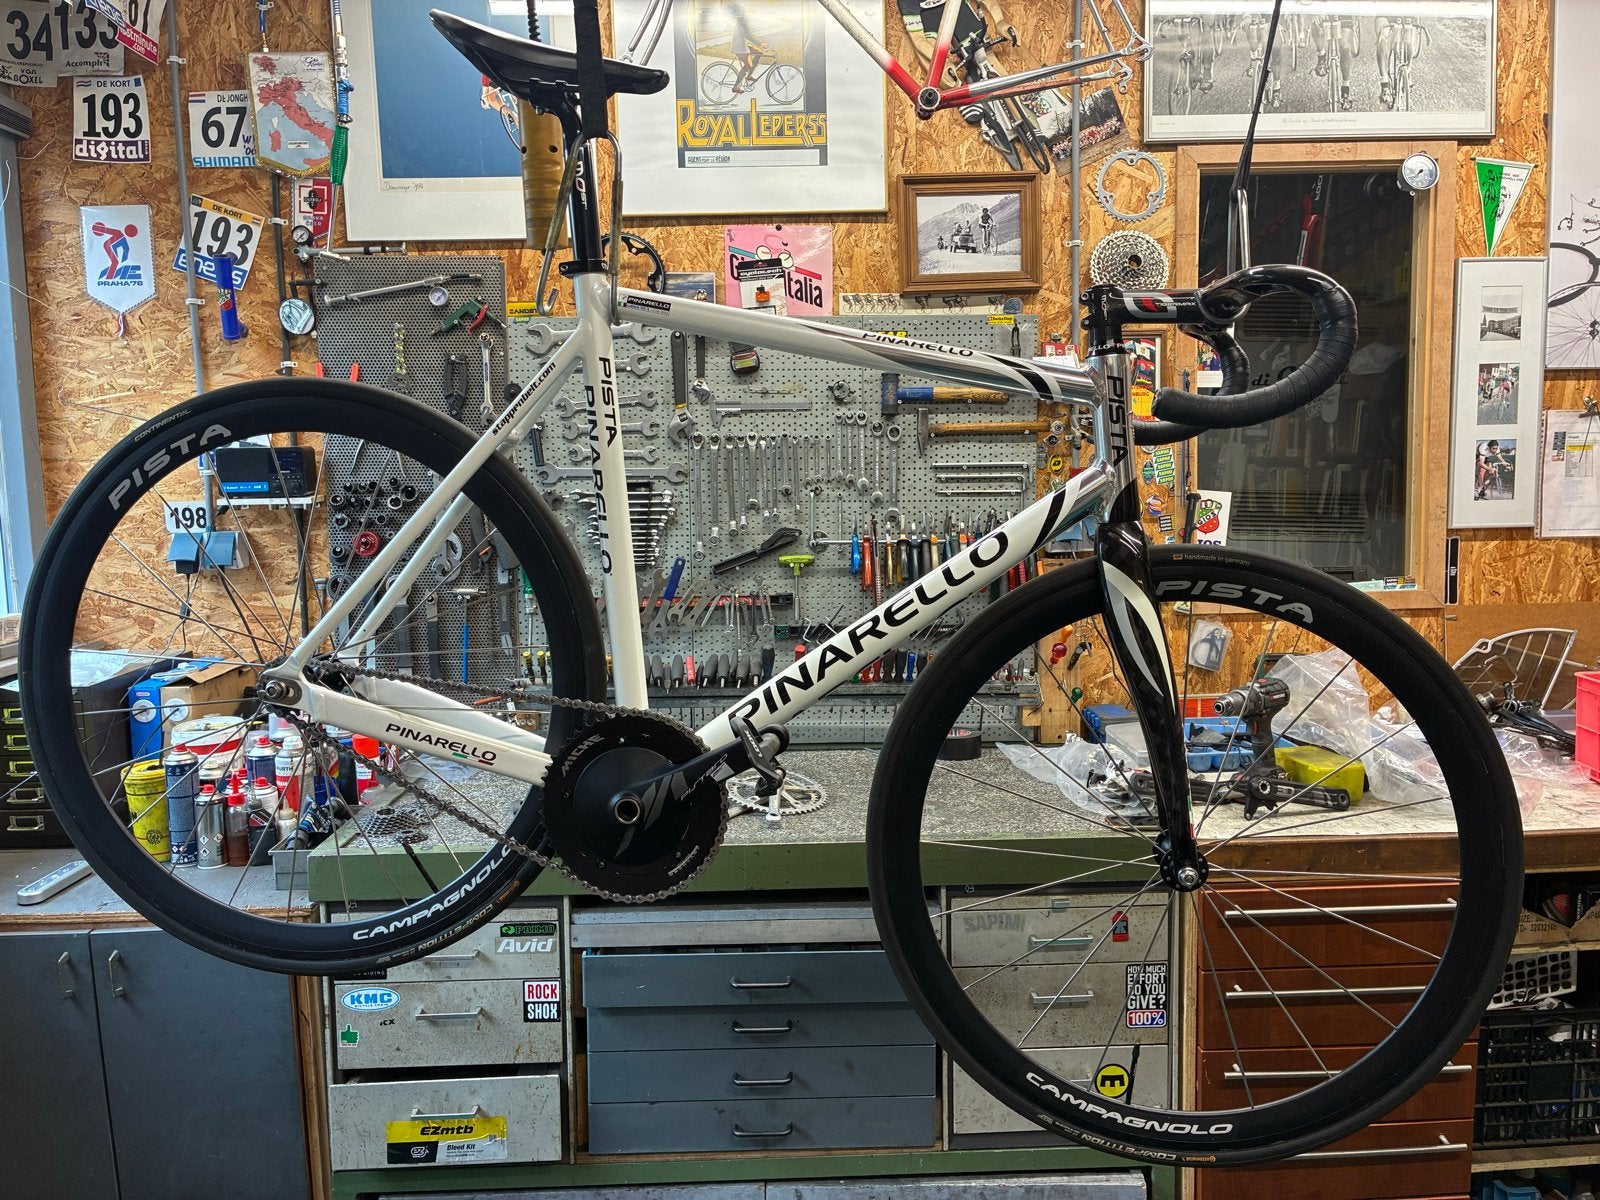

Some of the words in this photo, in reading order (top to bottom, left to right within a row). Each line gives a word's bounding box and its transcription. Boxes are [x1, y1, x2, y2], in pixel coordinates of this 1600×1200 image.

[110, 80, 131, 88] KORT
[82, 92, 143, 139] 193
[201, 106, 247, 148] 67
[676, 98, 750, 147] ROYAL
[750, 98, 828, 147] LEPERSS
[75, 140, 144, 160] digital
[212, 203, 222, 212] DE
[223, 207, 243, 219] KORT
[192, 210, 253, 266] 193
[628, 297, 670, 309] PINARELLO
[862, 332, 974, 357] PINARELLO
[599, 357, 618, 448] PISTA
[134, 409, 192, 442] CONTINENTAL
[1107, 375, 1128, 467] PISTA
[108, 424, 232, 511] PISTA
[585, 384, 612, 576] PINARELLO
[170, 507, 207, 529] 198
[1198, 511, 1216, 525] GIOS
[1184, 554, 1217, 562] handmade
[1225, 557, 1250, 567] germany
[1155, 580, 1314, 624] PISTA
[730, 531, 1009, 728] PINARELLO
[385, 723, 497, 761] PINARELLO
[562, 734, 605, 778] MICHE
[352, 845, 512, 941] CAMPAGNOLO
[497, 937, 554, 953] Avid
[1127, 965, 1141, 974] HOW
[1145, 965, 1166, 973] MUCH
[1127, 973, 1165, 984] EFFORT
[350, 993, 392, 1005] KMC
[527, 984, 558, 999] ROCK
[1127, 984, 1142, 995] DO
[1145, 983, 1166, 994] YOU
[527, 1002, 558, 1020] SHOX
[1127, 995, 1165, 1010] GIVE?
[1129, 1012, 1164, 1026] 100%
[1025, 1072, 1234, 1135] CAMPAGNOLO
[420, 1124, 474, 1136] EZmtb
[1081, 1133, 1177, 1161] COMPETITION
